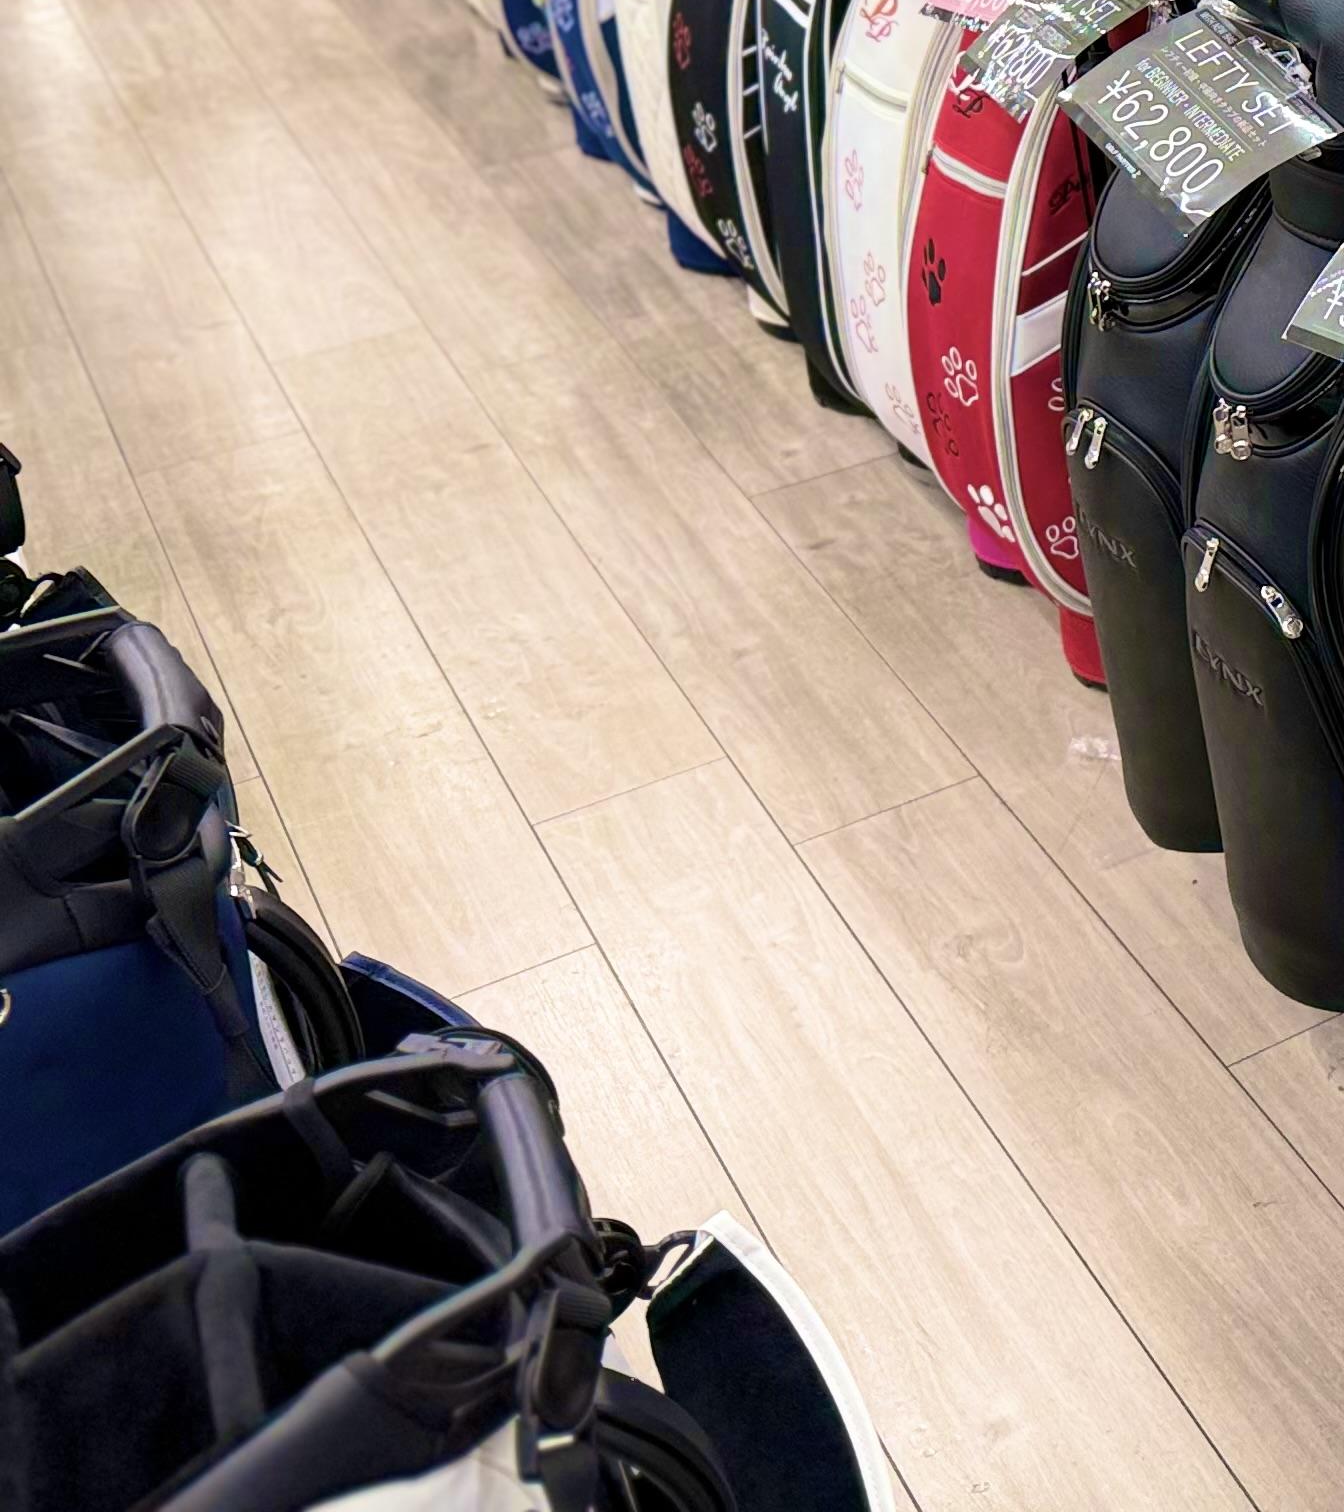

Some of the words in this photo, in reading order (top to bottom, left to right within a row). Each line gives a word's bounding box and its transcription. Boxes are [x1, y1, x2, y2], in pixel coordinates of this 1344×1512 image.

[1096, 69, 1225, 194] ¥62,800
[1146, 63, 1190, 108] BEGINNER
[1182, 102, 1248, 163] INTERMEDIATE
[1173, 28, 1260, 96] LEFTY
[1241, 89, 1298, 136] SET
